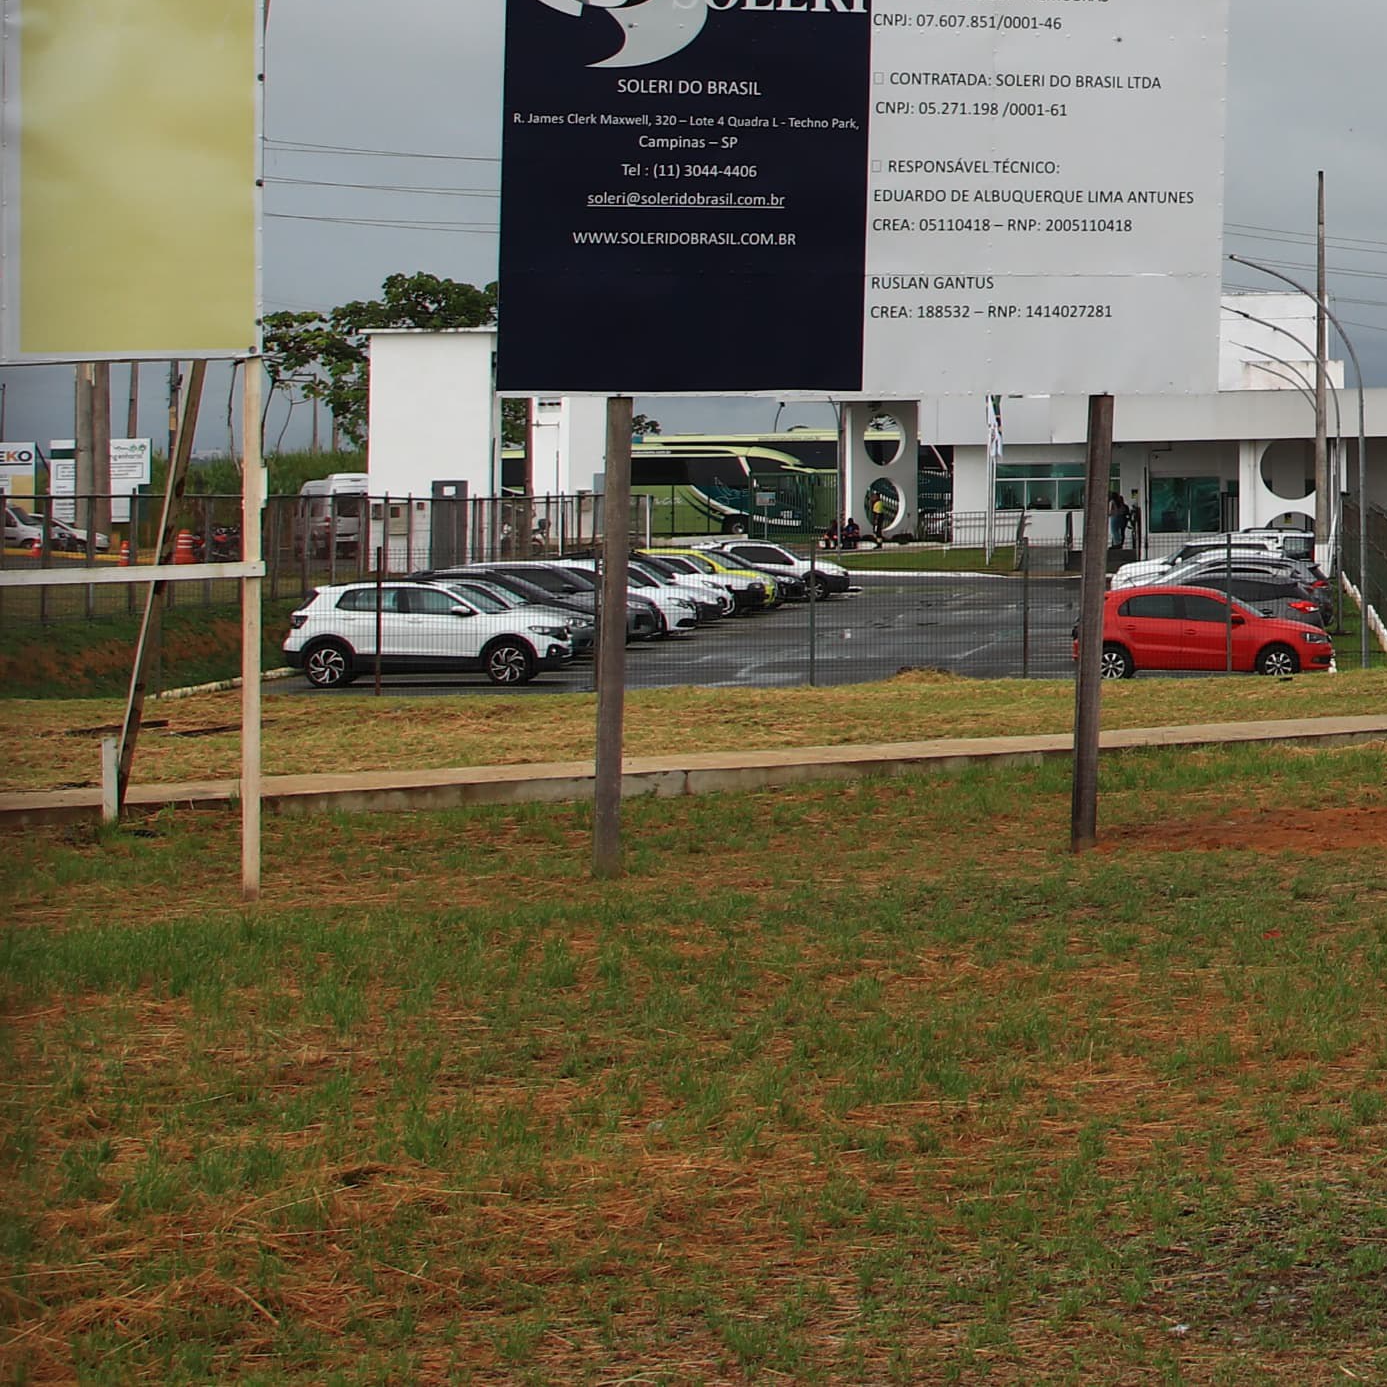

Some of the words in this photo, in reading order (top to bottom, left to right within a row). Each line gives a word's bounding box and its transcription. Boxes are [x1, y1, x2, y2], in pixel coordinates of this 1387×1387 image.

[874, 14, 912, 27] CNPJ:
[917, 14, 1061, 30] 07.607.851/0001-46
[618, 79, 672, 93] SOLERI
[679, 81, 702, 94] DO
[708, 81, 761, 95] BRASIL
[889, 72, 992, 86] CONTRATADA:
[996, 74, 1044, 86] SOLERI
[1050, 75, 1071, 87] DO
[1076, 76, 1123, 88] BRASIL
[1128, 77, 1161, 88] LTDA
[876, 102, 914, 115] CNPJ:
[919, 102, 998, 115] 05.271.198
[1003, 102, 1066, 117] /0001-61
[514, 113, 524, 123] R.
[528, 114, 564, 123] James
[568, 114, 596, 124] Clerk
[601, 115, 651, 126] Maxwell,
[656, 115, 676, 125] 320
[690, 116, 714, 126] Lote
[717, 117, 724, 125] 4
[728, 117, 769, 127] Quadra
[773, 118, 778, 127] L
[788, 118, 828, 127] Techno
[832, 118, 858, 129] Park,
[639, 136, 705, 150] Campinas
[722, 137, 737, 148] SP
[622, 164, 640, 176] Tel
[654, 164, 680, 178] (11)
[685, 165, 757, 177] 3044-4406
[889, 158, 989, 173] RESPONSÁVEL
[992, 159, 1060, 174] TÉCNICO:
[587, 192, 784, 208] soleri@soleridobrasil.com.br
[874, 190, 946, 202] EDUARDO
[952, 190, 969, 202] DE
[974, 190, 1083, 203] ALBUQUERQUE
[1089, 191, 1123, 202] LIMA
[1128, 191, 1193, 203] ANTUNES
[872, 218, 915, 231] CREA:
[920, 219, 990, 231] 05110418
[1007, 219, 1041, 232] RNP:
[1046, 219, 1132, 231] 2005110418
[573, 232, 795, 245] WWW.SOLERIDOBRASIL.COM.BR
[872, 277, 928, 289] RUSLAN
[934, 277, 993, 289] GANTUS
[871, 306, 913, 318] CREA:
[918, 306, 969, 318] 188532
[988, 306, 1021, 318] RNP:
[1027, 305, 1111, 317] 1414027281
